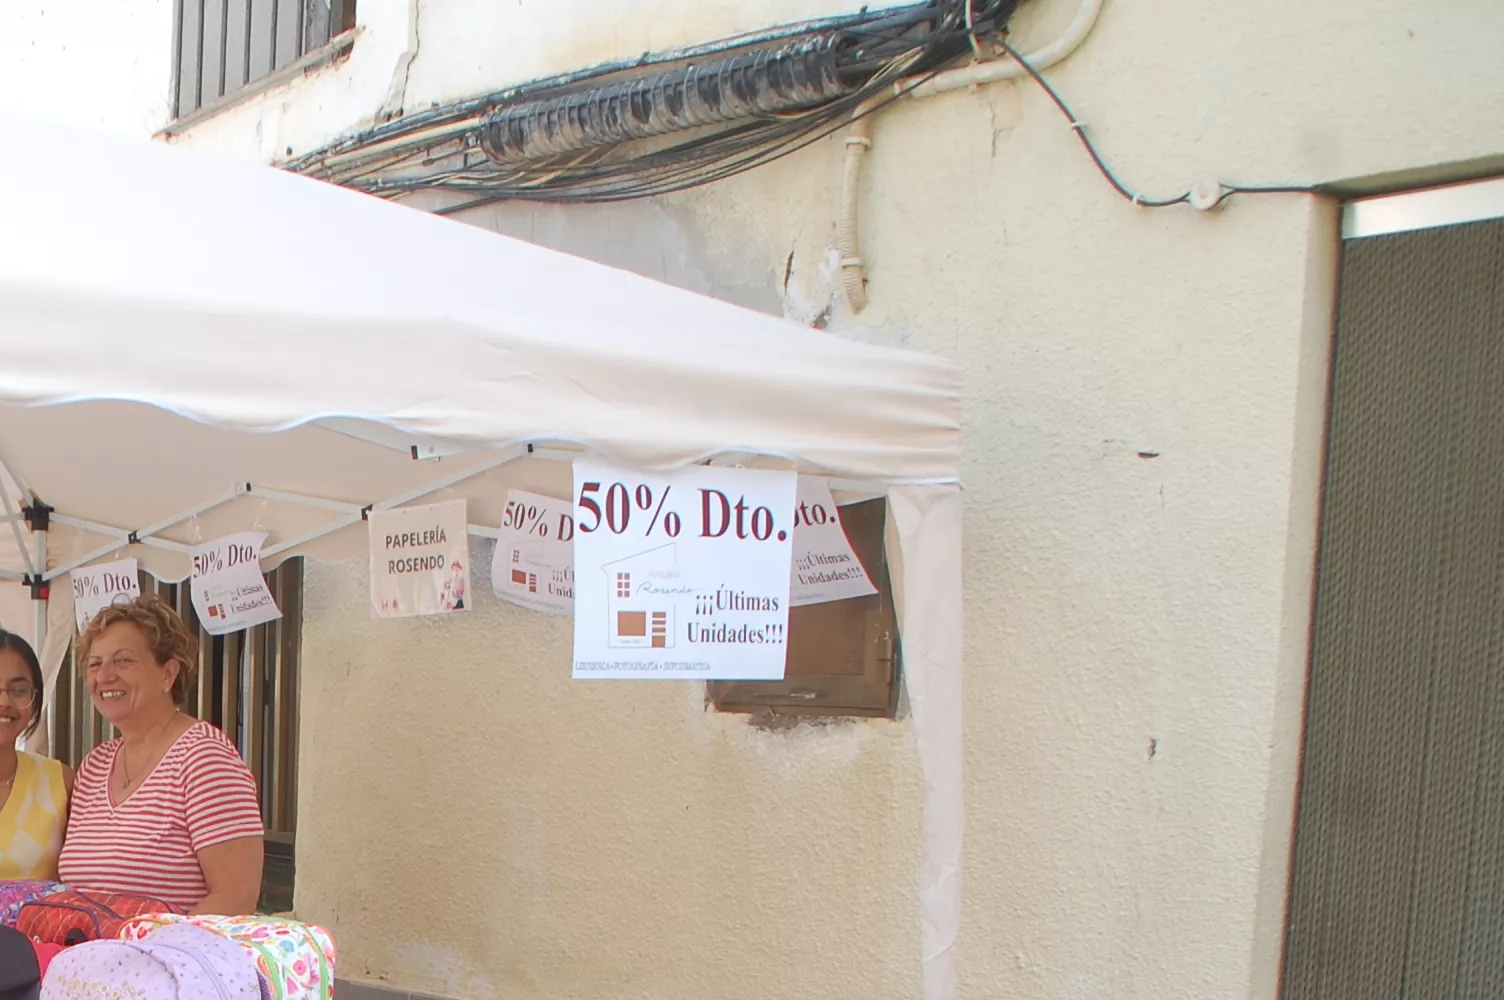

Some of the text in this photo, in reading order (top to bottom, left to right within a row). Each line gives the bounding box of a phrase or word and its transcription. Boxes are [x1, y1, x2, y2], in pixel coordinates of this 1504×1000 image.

[503, 500, 548, 538] 50%
[577, 481, 788, 542] 50% Dto.
[793, 499, 836, 529] to.
[385, 525, 447, 549] PAPELERÍA
[193, 543, 258, 579] 50% Dto.
[387, 554, 445, 576] ROSENDO
[103, 572, 137, 594] Dto.
[695, 583, 779, 616] ¡¡¡Últimas
[686, 622, 783, 645] Unidades!!!
